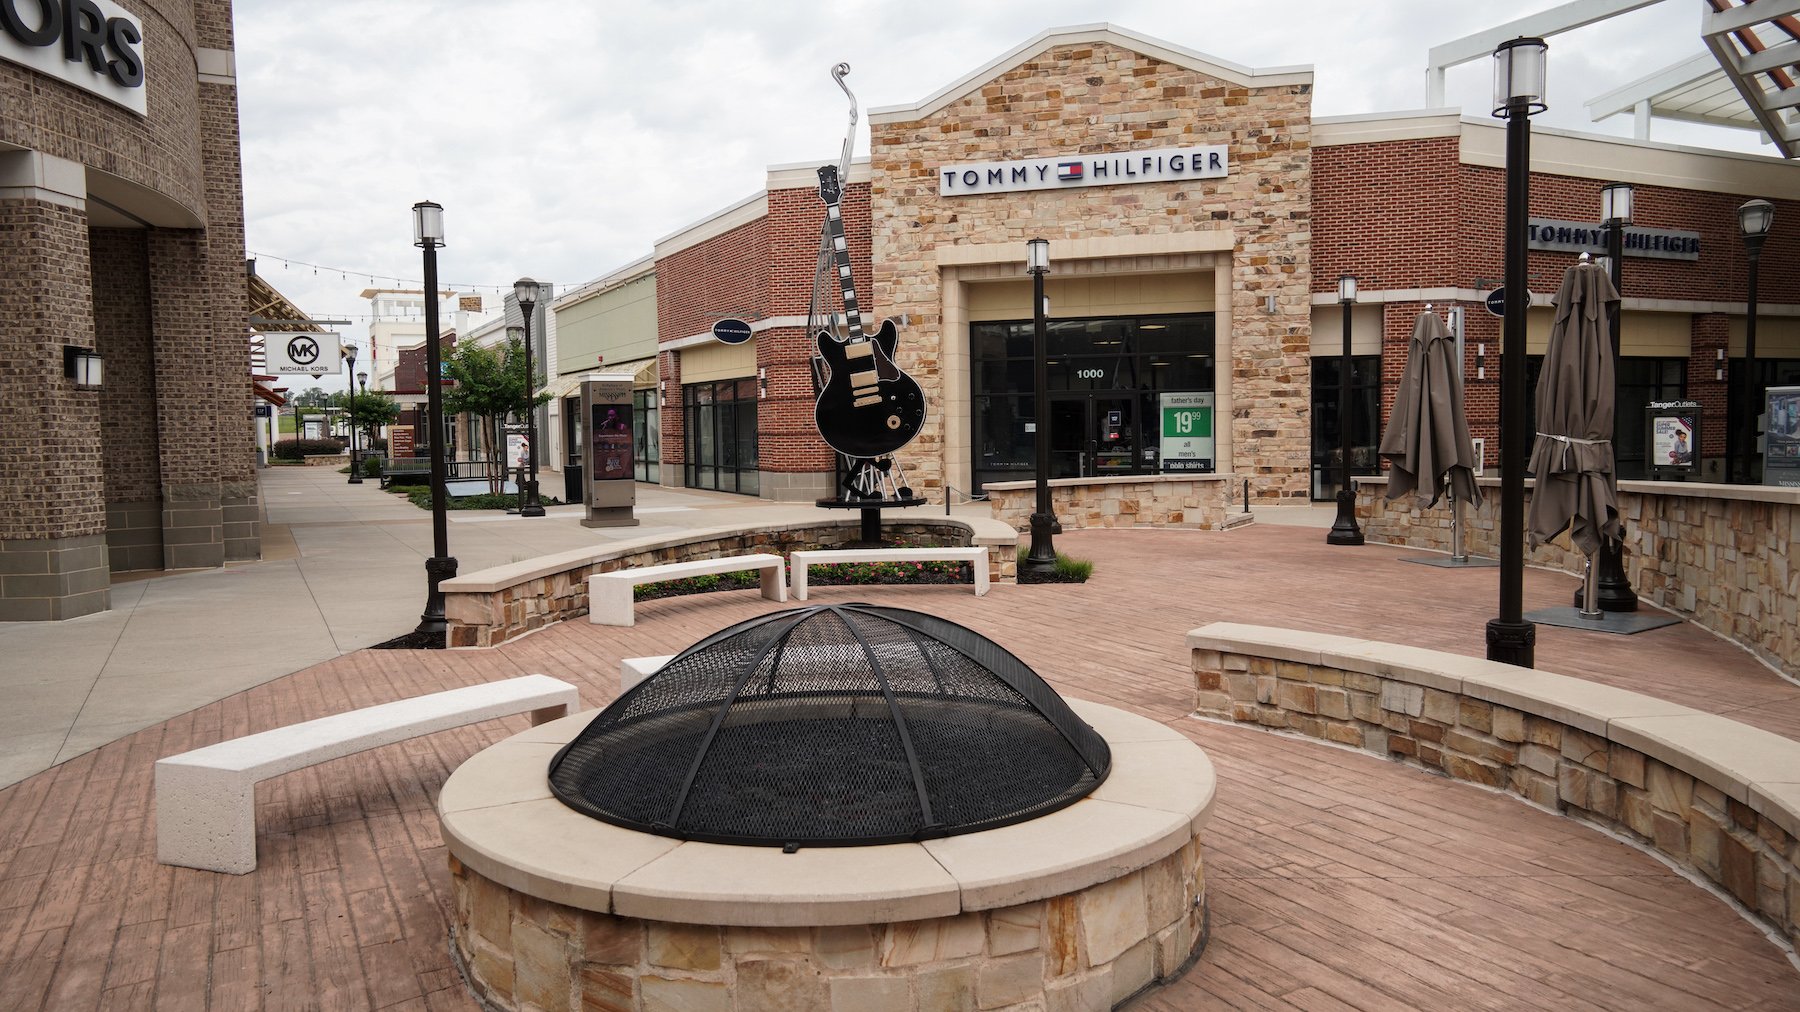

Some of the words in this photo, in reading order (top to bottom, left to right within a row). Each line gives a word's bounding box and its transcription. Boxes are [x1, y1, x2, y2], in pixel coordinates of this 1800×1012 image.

[0, 0, 144, 88] ORS
[943, 164, 1049, 188] TOMMY
[1093, 152, 1222, 178] HILFIGER
[1529, 224, 1601, 245] TOMMY
[1625, 232, 1699, 254] HILFIGER
[291, 344, 316, 357] MK
[1076, 369, 1104, 378] 1000
[1650, 401, 1697, 409] TangerOutlets
